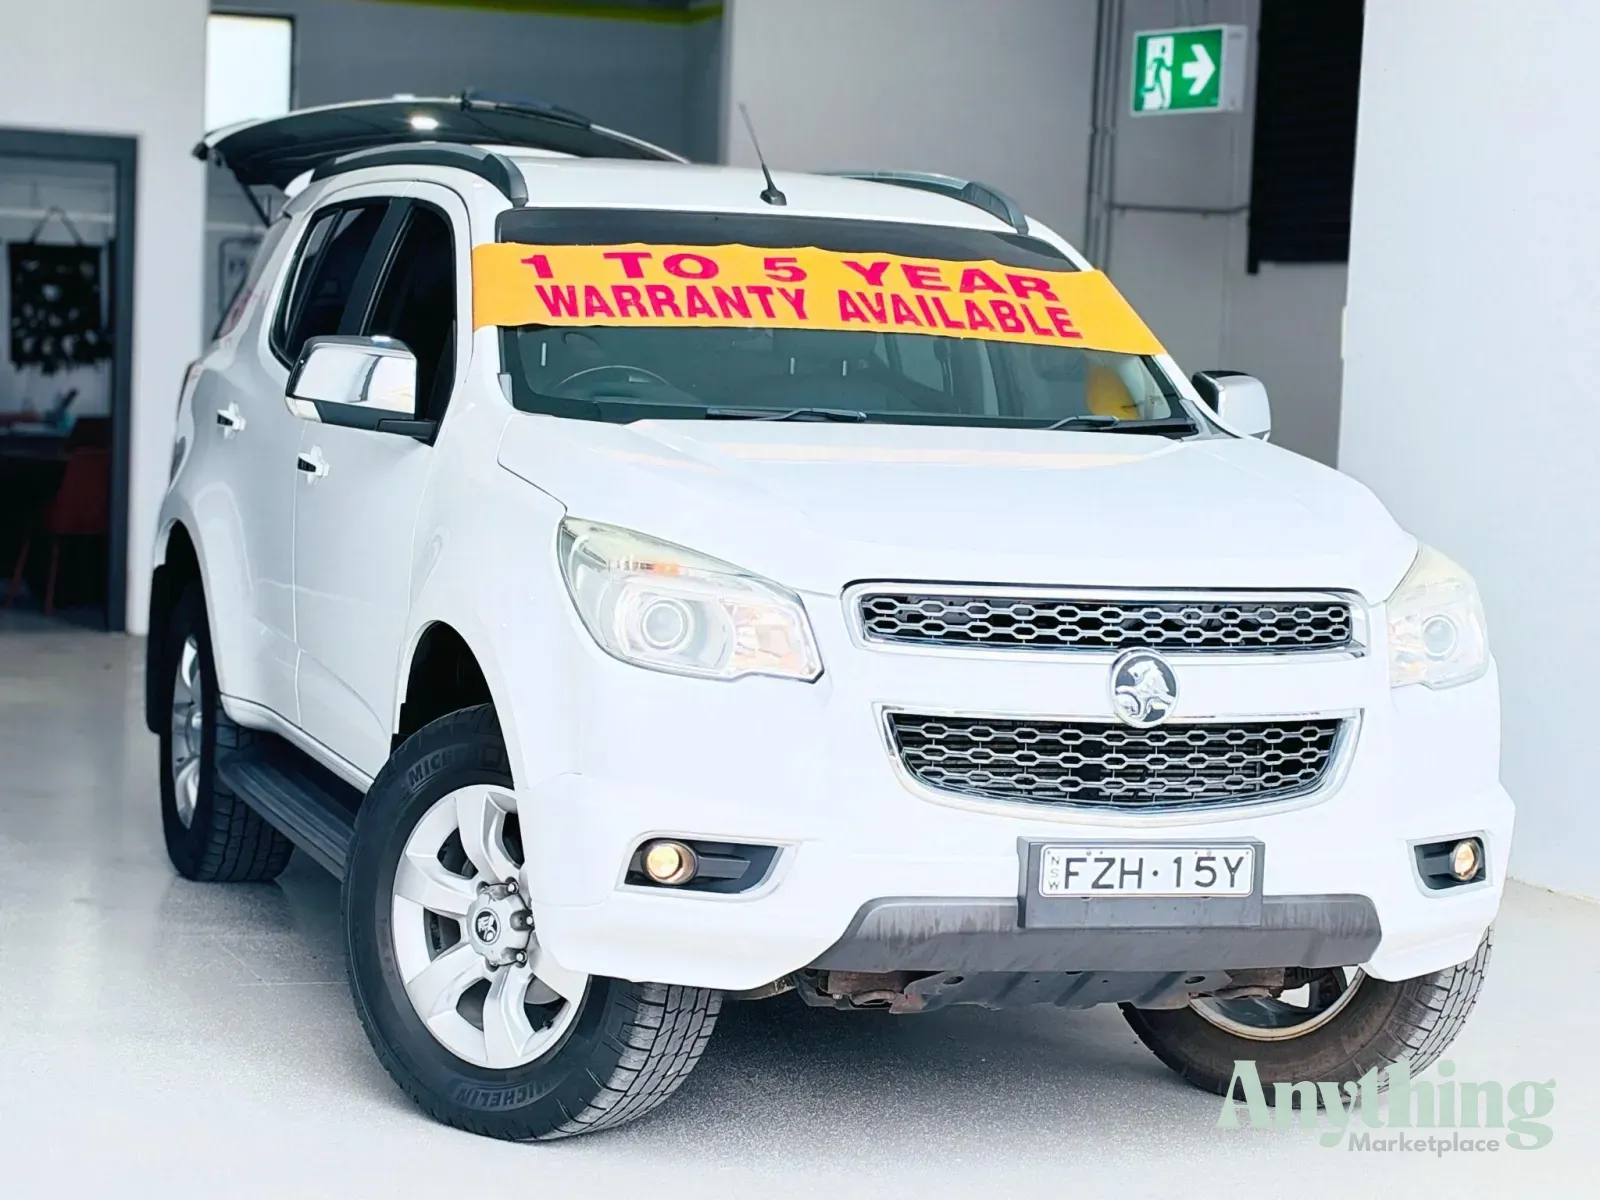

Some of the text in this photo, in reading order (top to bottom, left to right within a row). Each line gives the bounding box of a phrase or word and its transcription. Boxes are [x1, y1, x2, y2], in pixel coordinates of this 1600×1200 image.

[520, 252, 1060, 302] 1 TO 5 YEAR
[534, 284, 1083, 339] WARRANTY AVAILABLE
